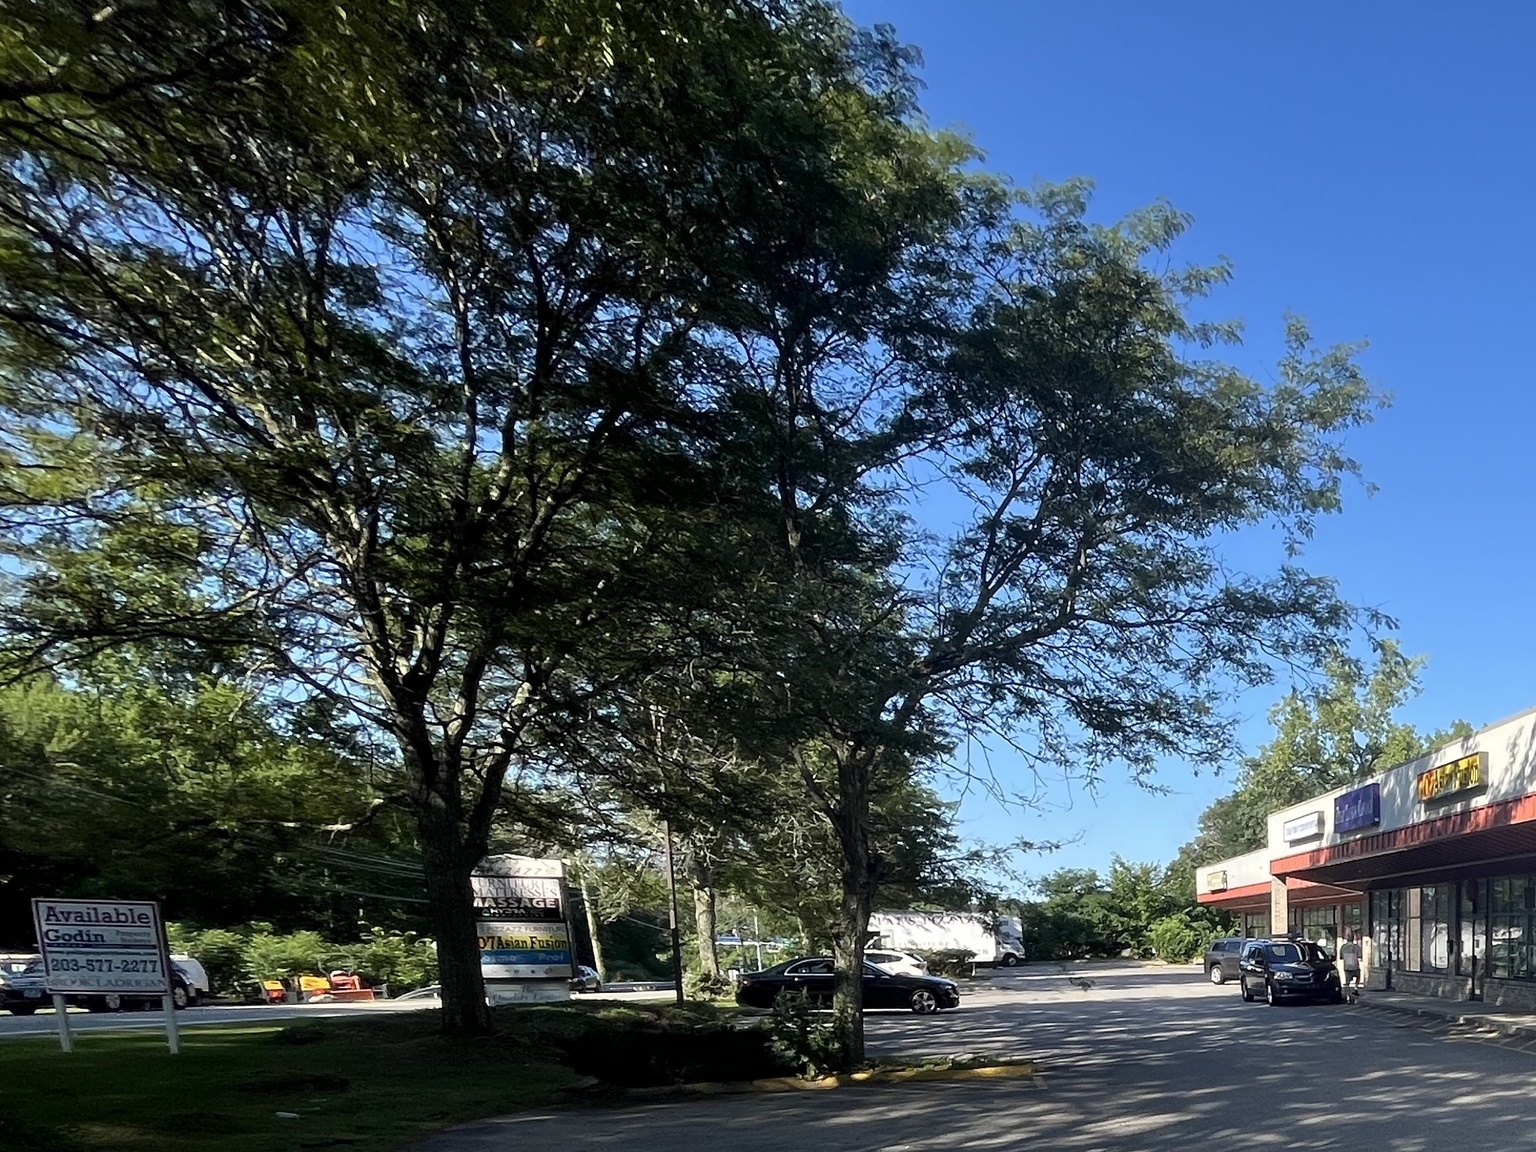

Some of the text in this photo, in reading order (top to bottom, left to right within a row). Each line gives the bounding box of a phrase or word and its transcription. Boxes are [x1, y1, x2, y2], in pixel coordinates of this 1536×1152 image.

[473, 898, 556, 908] MASSAGE
[44, 906, 151, 925] Available
[44, 929, 105, 943] Godin
[496, 936, 528, 949] Asian
[529, 936, 568, 950] Fusion
[51, 958, 157, 973] 203-577-2277
